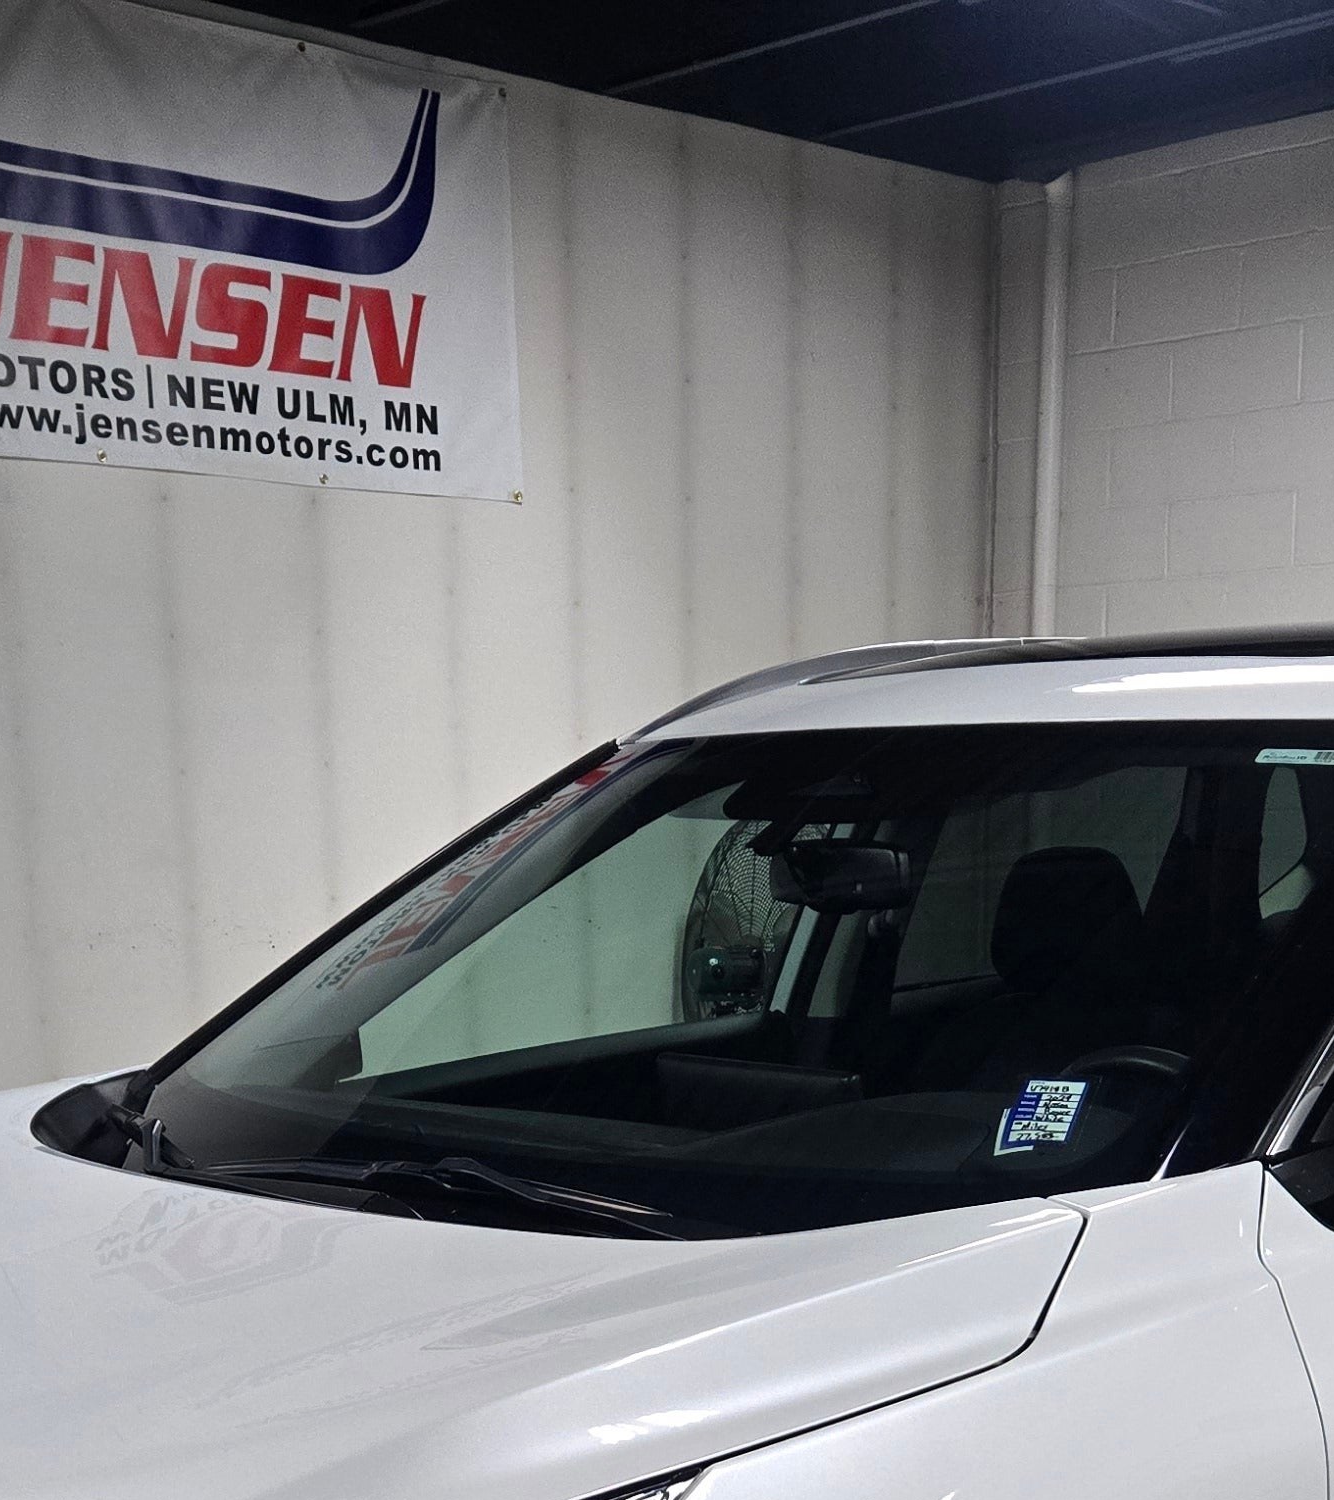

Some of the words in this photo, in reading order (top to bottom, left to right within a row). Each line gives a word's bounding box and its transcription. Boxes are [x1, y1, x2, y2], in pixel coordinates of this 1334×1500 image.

[166, 373, 260, 416] NEW
[276, 386, 367, 437] ULM,
[383, 399, 439, 436] MN
